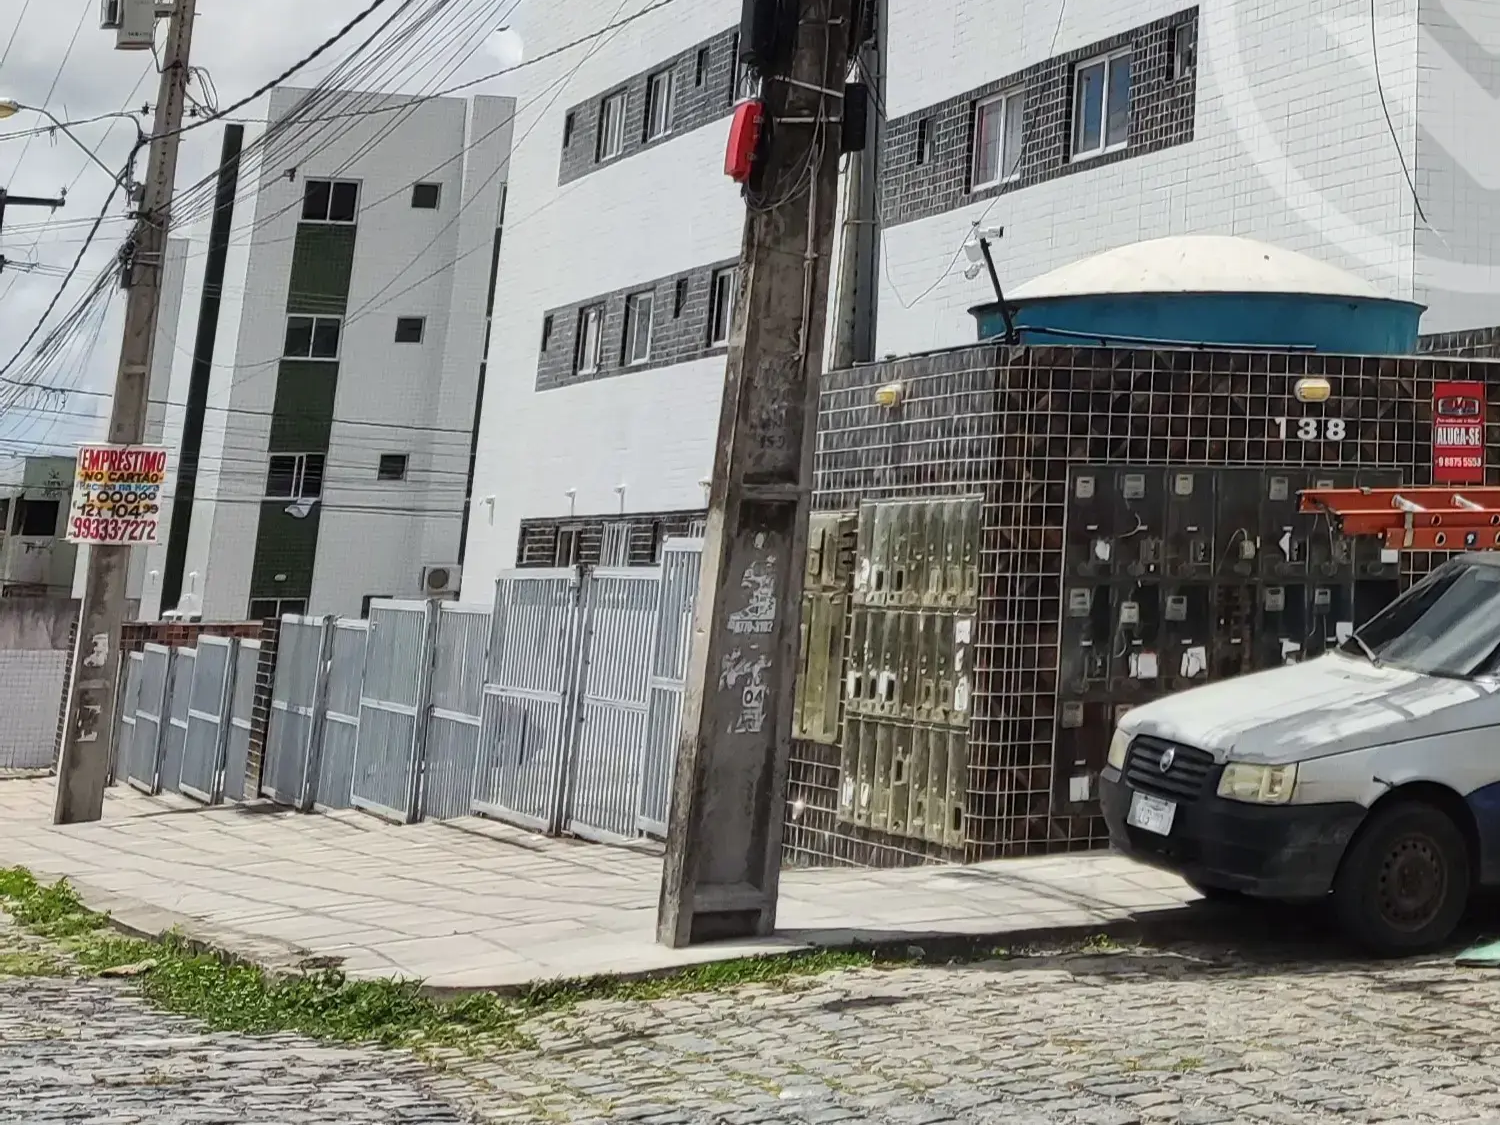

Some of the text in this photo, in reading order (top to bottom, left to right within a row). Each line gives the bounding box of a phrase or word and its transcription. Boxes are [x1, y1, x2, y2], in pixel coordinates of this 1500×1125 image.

[1274, 416, 1346, 441] 138
[1437, 426, 1480, 446] ALUGA-SE
[72, 517, 156, 541] 99333-7272
